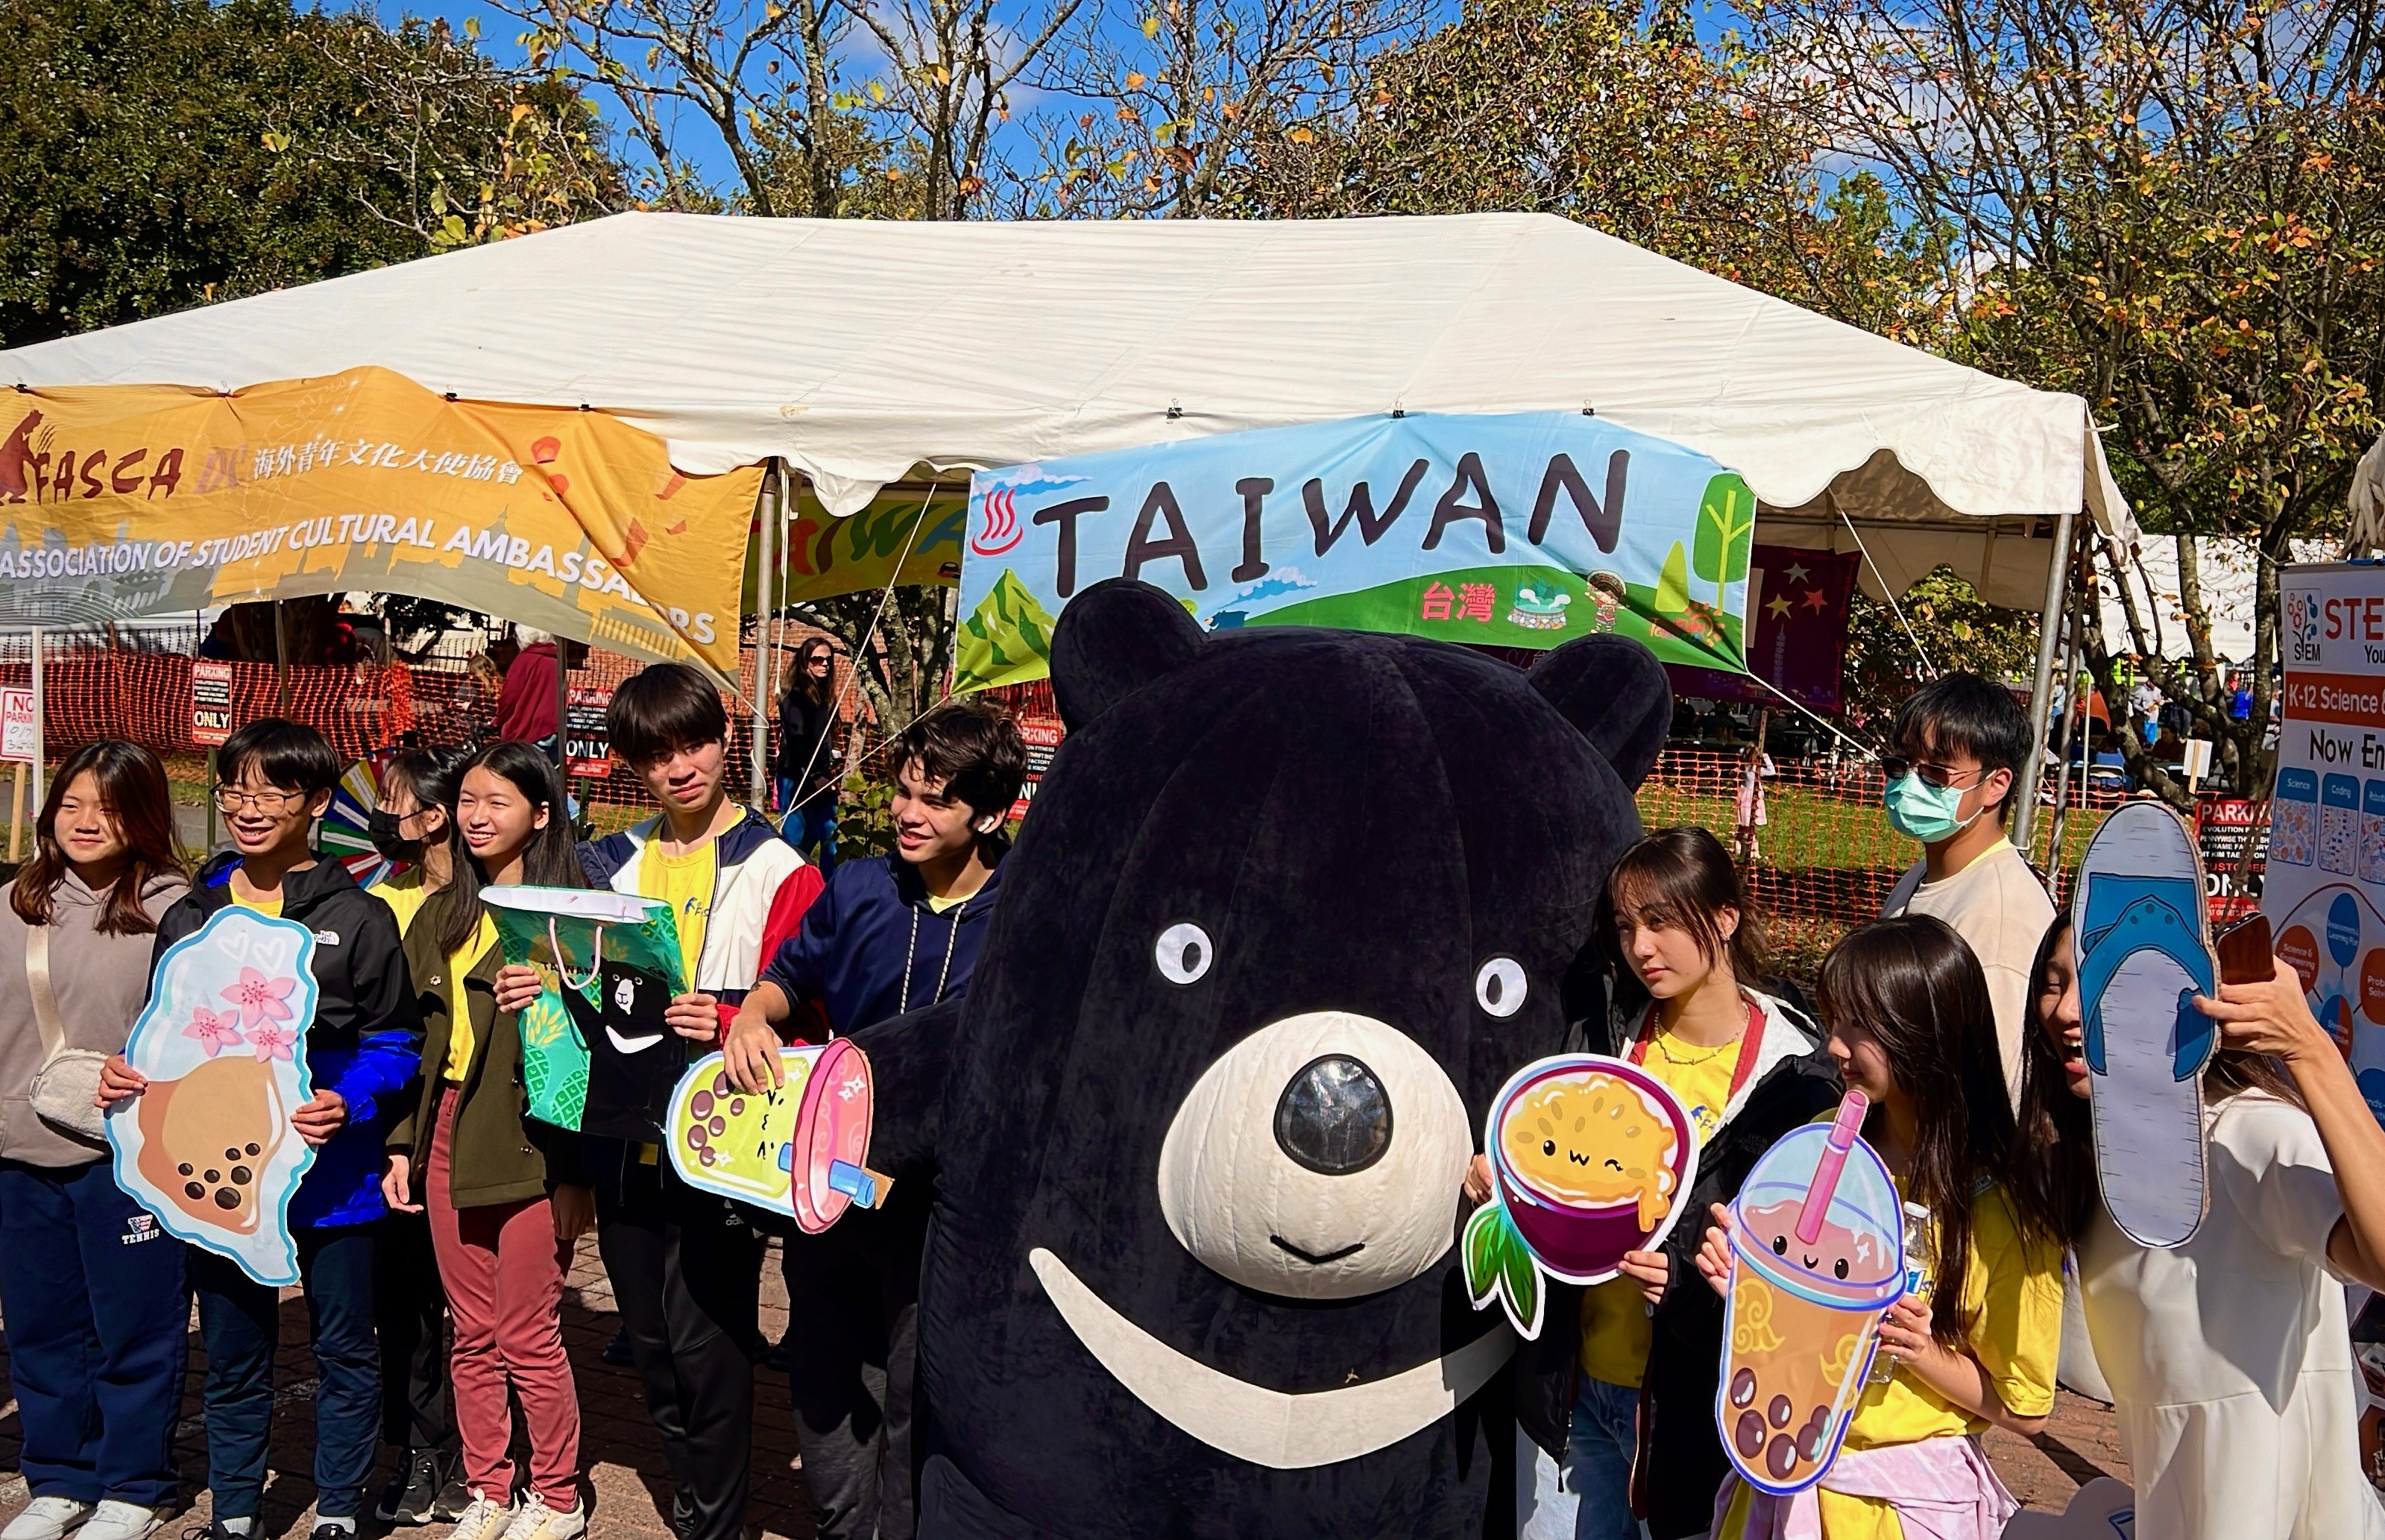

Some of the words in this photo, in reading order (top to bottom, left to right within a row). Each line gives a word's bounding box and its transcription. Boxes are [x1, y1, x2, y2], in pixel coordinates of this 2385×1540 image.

[36, 448, 184, 505] FASCA
[253, 439, 523, 485] 海外青年文化大使協會
[1033, 449, 1631, 599] TAIWAN
[0, 543, 152, 578] ASSOCIATION
[154, 541, 194, 568] OF
[191, 526, 290, 567] STUDENT
[289, 514, 437, 550] CULTURAL
[444, 526, 716, 644] AMBASSARS
[1422, 581, 1496, 623] 台灣
[194, 664, 230, 680] PARKING
[2289, 684, 2316, 708] K-12
[2320, 686, 2378, 713] Science
[194, 710, 230, 729] ONLY
[1022, 727, 1058, 743] RKING
[566, 739, 609, 759] ONLY
[2310, 728, 2353, 765] Now
[541, 960, 594, 976] TAWAN
